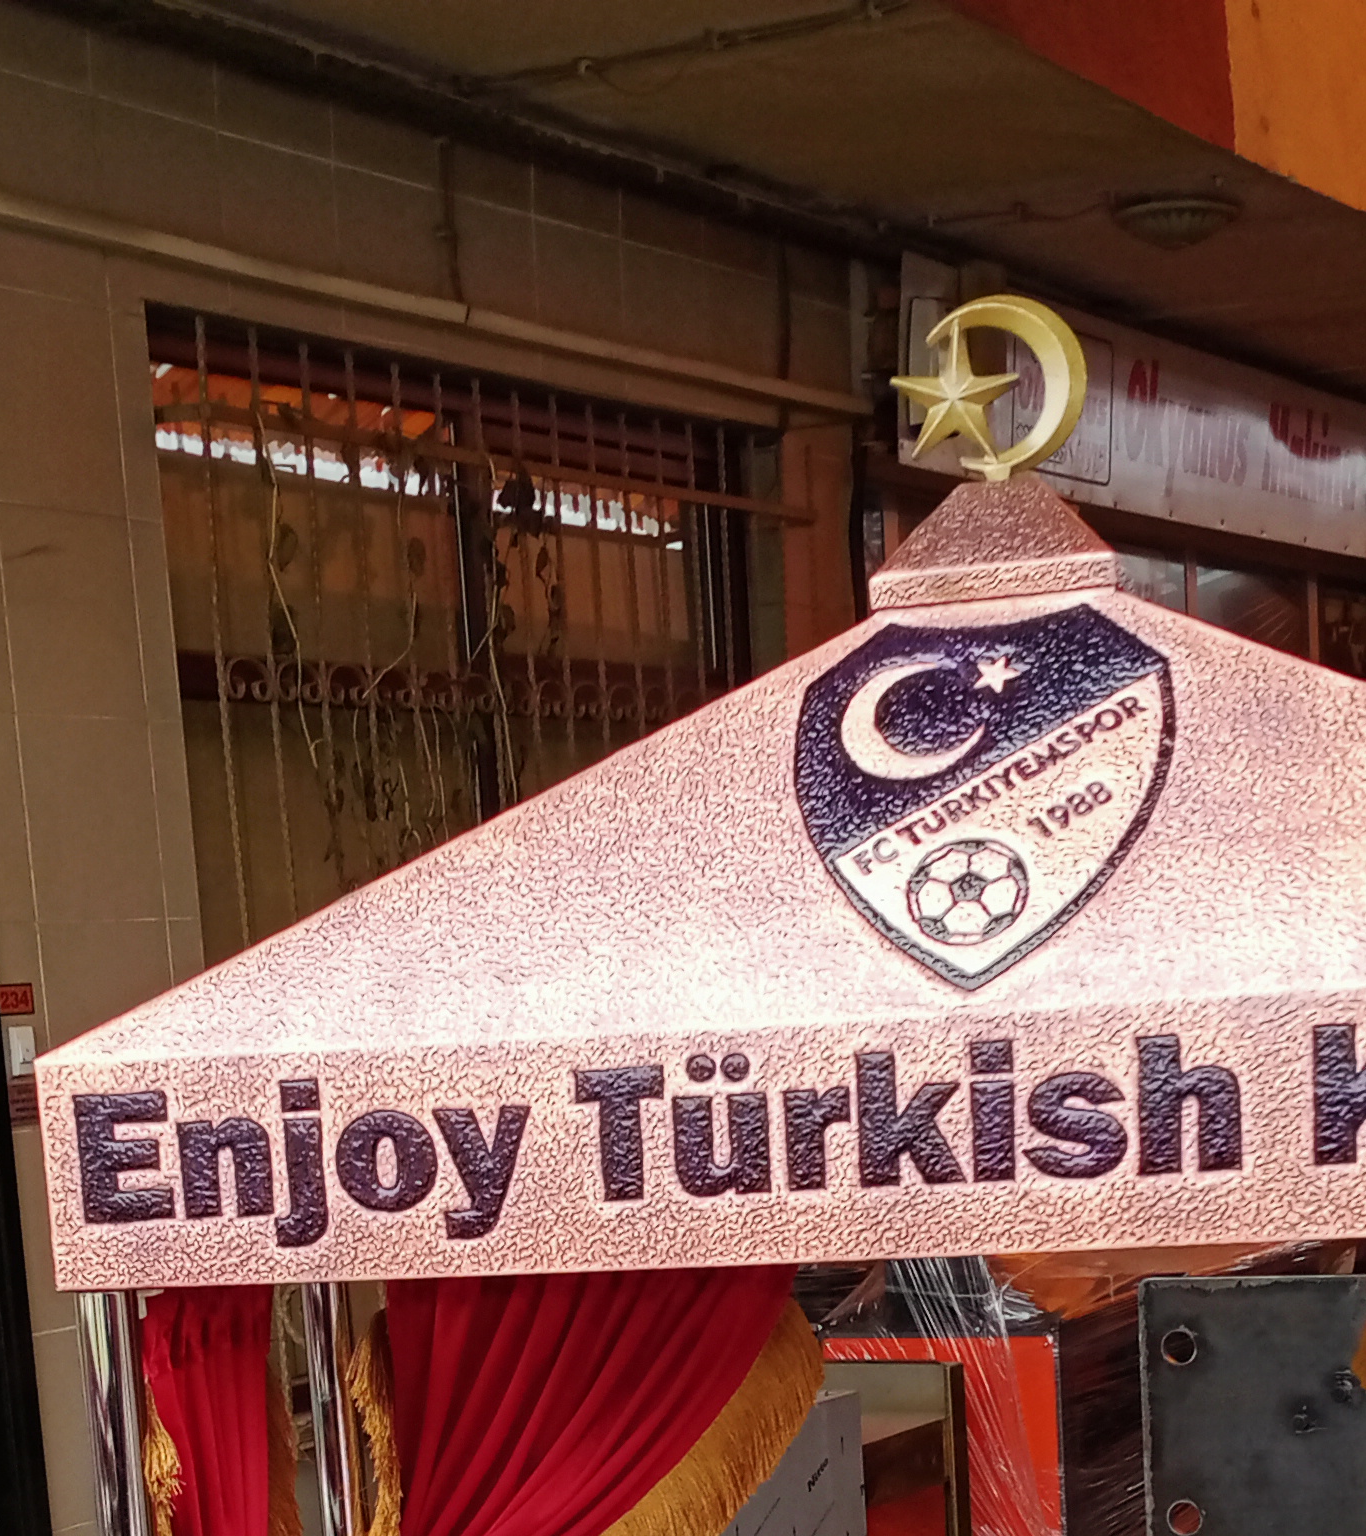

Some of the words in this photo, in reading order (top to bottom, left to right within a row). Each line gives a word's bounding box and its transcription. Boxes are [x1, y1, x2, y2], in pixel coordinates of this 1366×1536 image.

[852, 837, 899, 876] FC
[895, 696, 1148, 846] TURKIYEMSPOR
[1027, 781, 1113, 838] 1988
[70, 1077, 532, 1248] Enjoy
[571, 1034, 1244, 1204] Türkish
